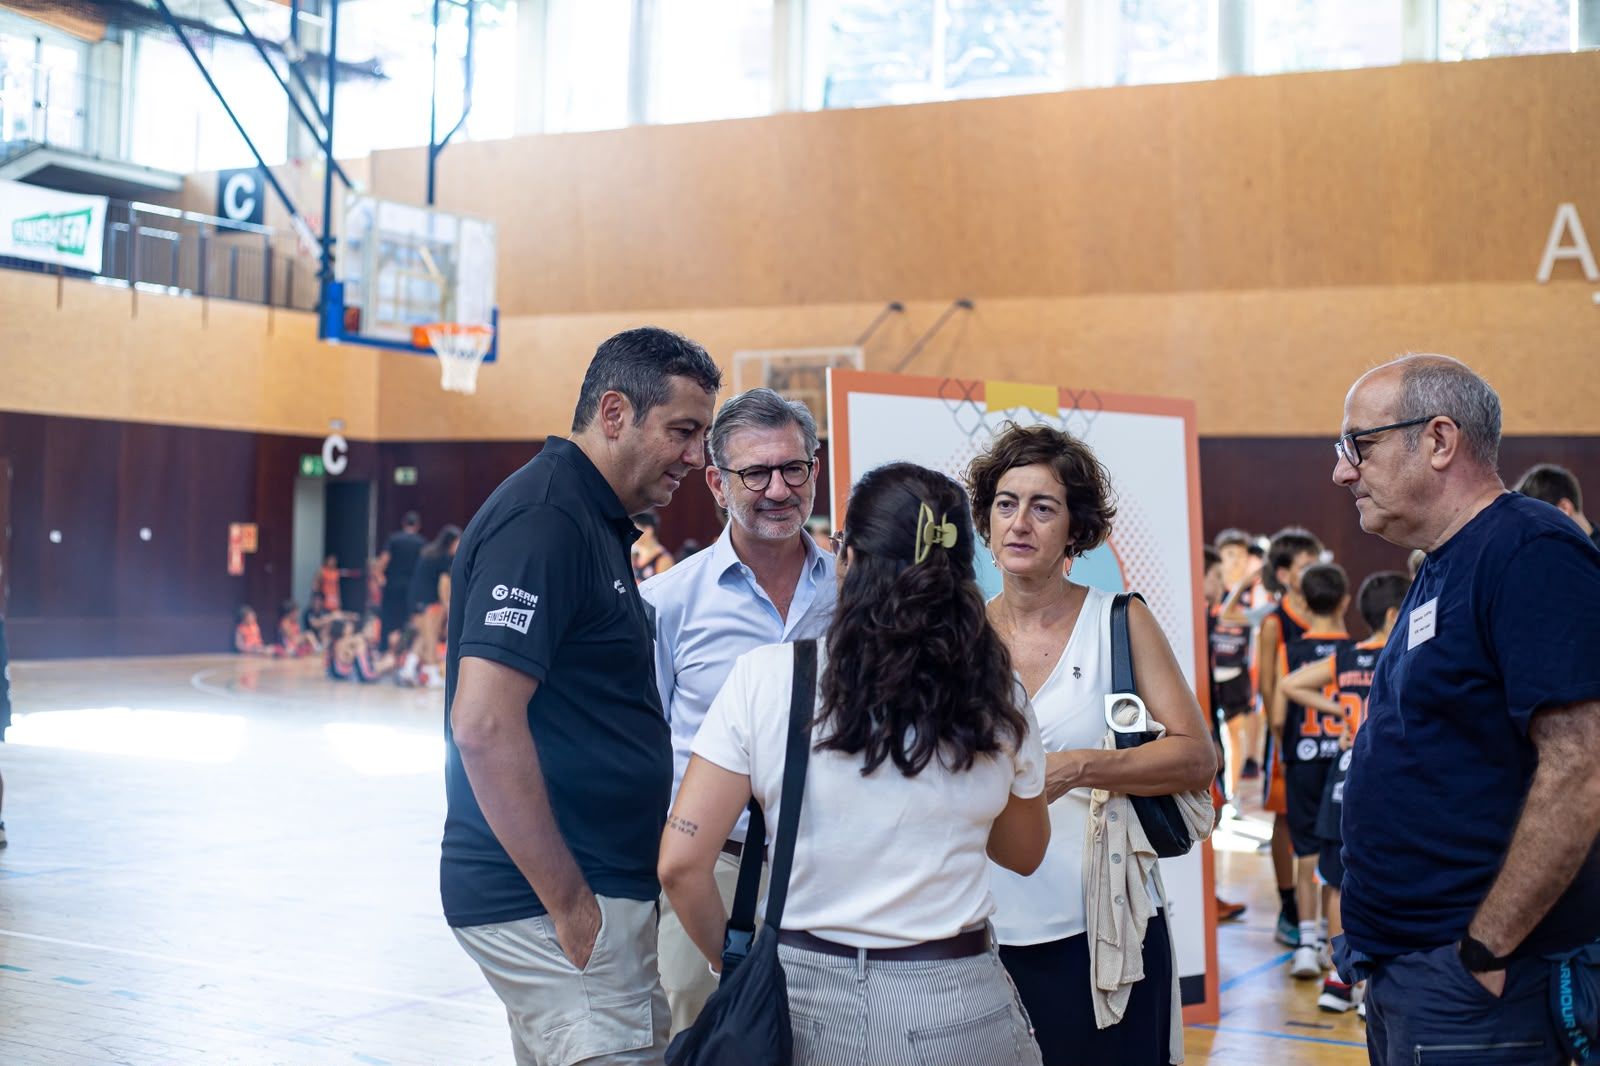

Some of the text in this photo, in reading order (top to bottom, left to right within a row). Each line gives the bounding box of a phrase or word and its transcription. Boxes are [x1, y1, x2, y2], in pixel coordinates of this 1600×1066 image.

[223, 172, 256, 222] C
[1536, 202, 1600, 285] A
[322, 433, 348, 475] C
[511, 587, 538, 604] KERN
[486, 609, 530, 629] FINISHER
